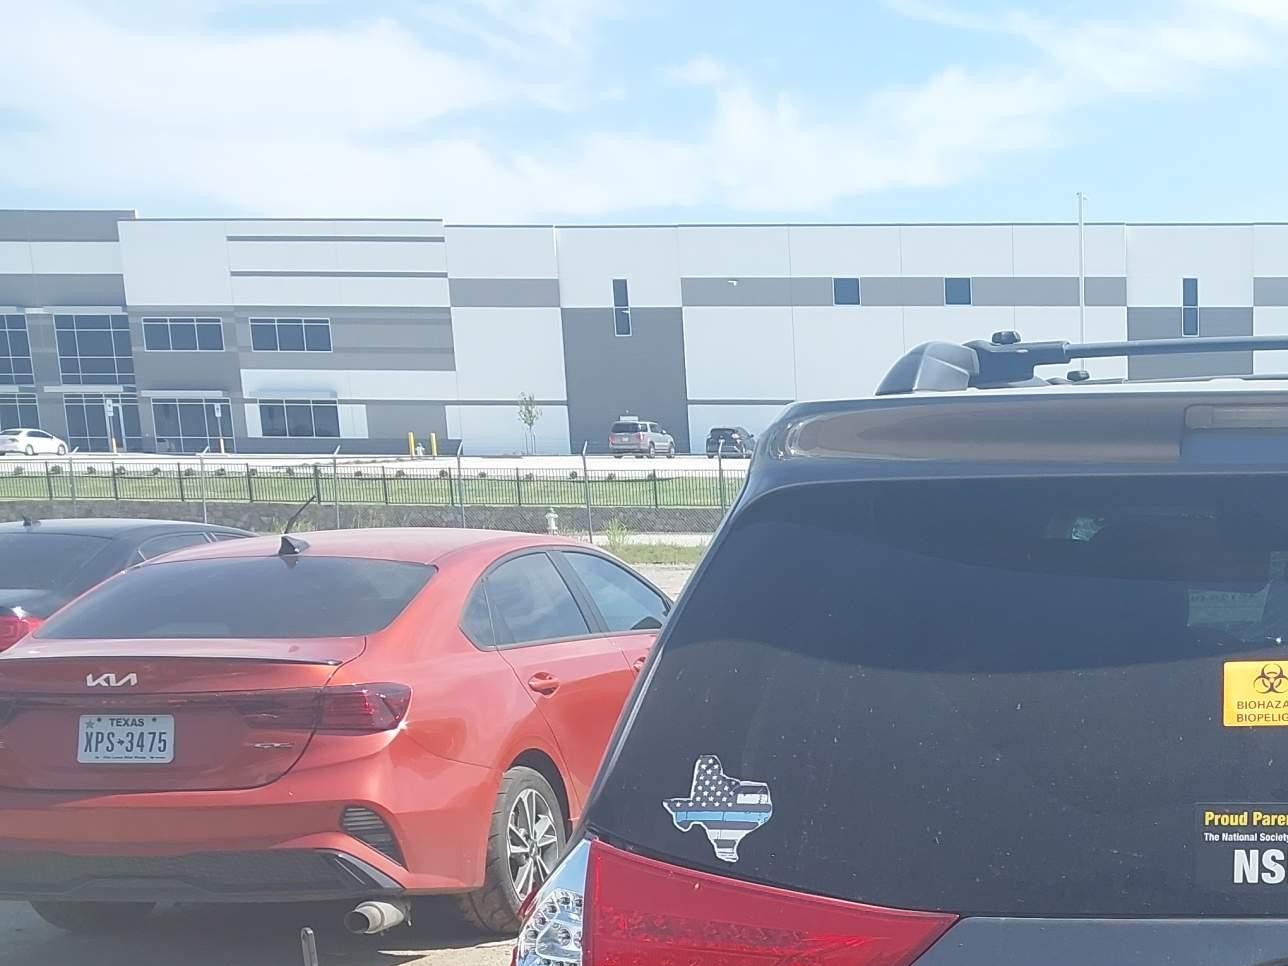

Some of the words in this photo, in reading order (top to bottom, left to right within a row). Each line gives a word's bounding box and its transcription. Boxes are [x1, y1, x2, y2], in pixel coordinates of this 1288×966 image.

[86, 672, 138, 687] KIA
[109, 717, 145, 727] TEXAS
[1204, 811, 1249, 827] Proud
[1203, 832, 1220, 842] The
[1221, 832, 1258, 842] National
